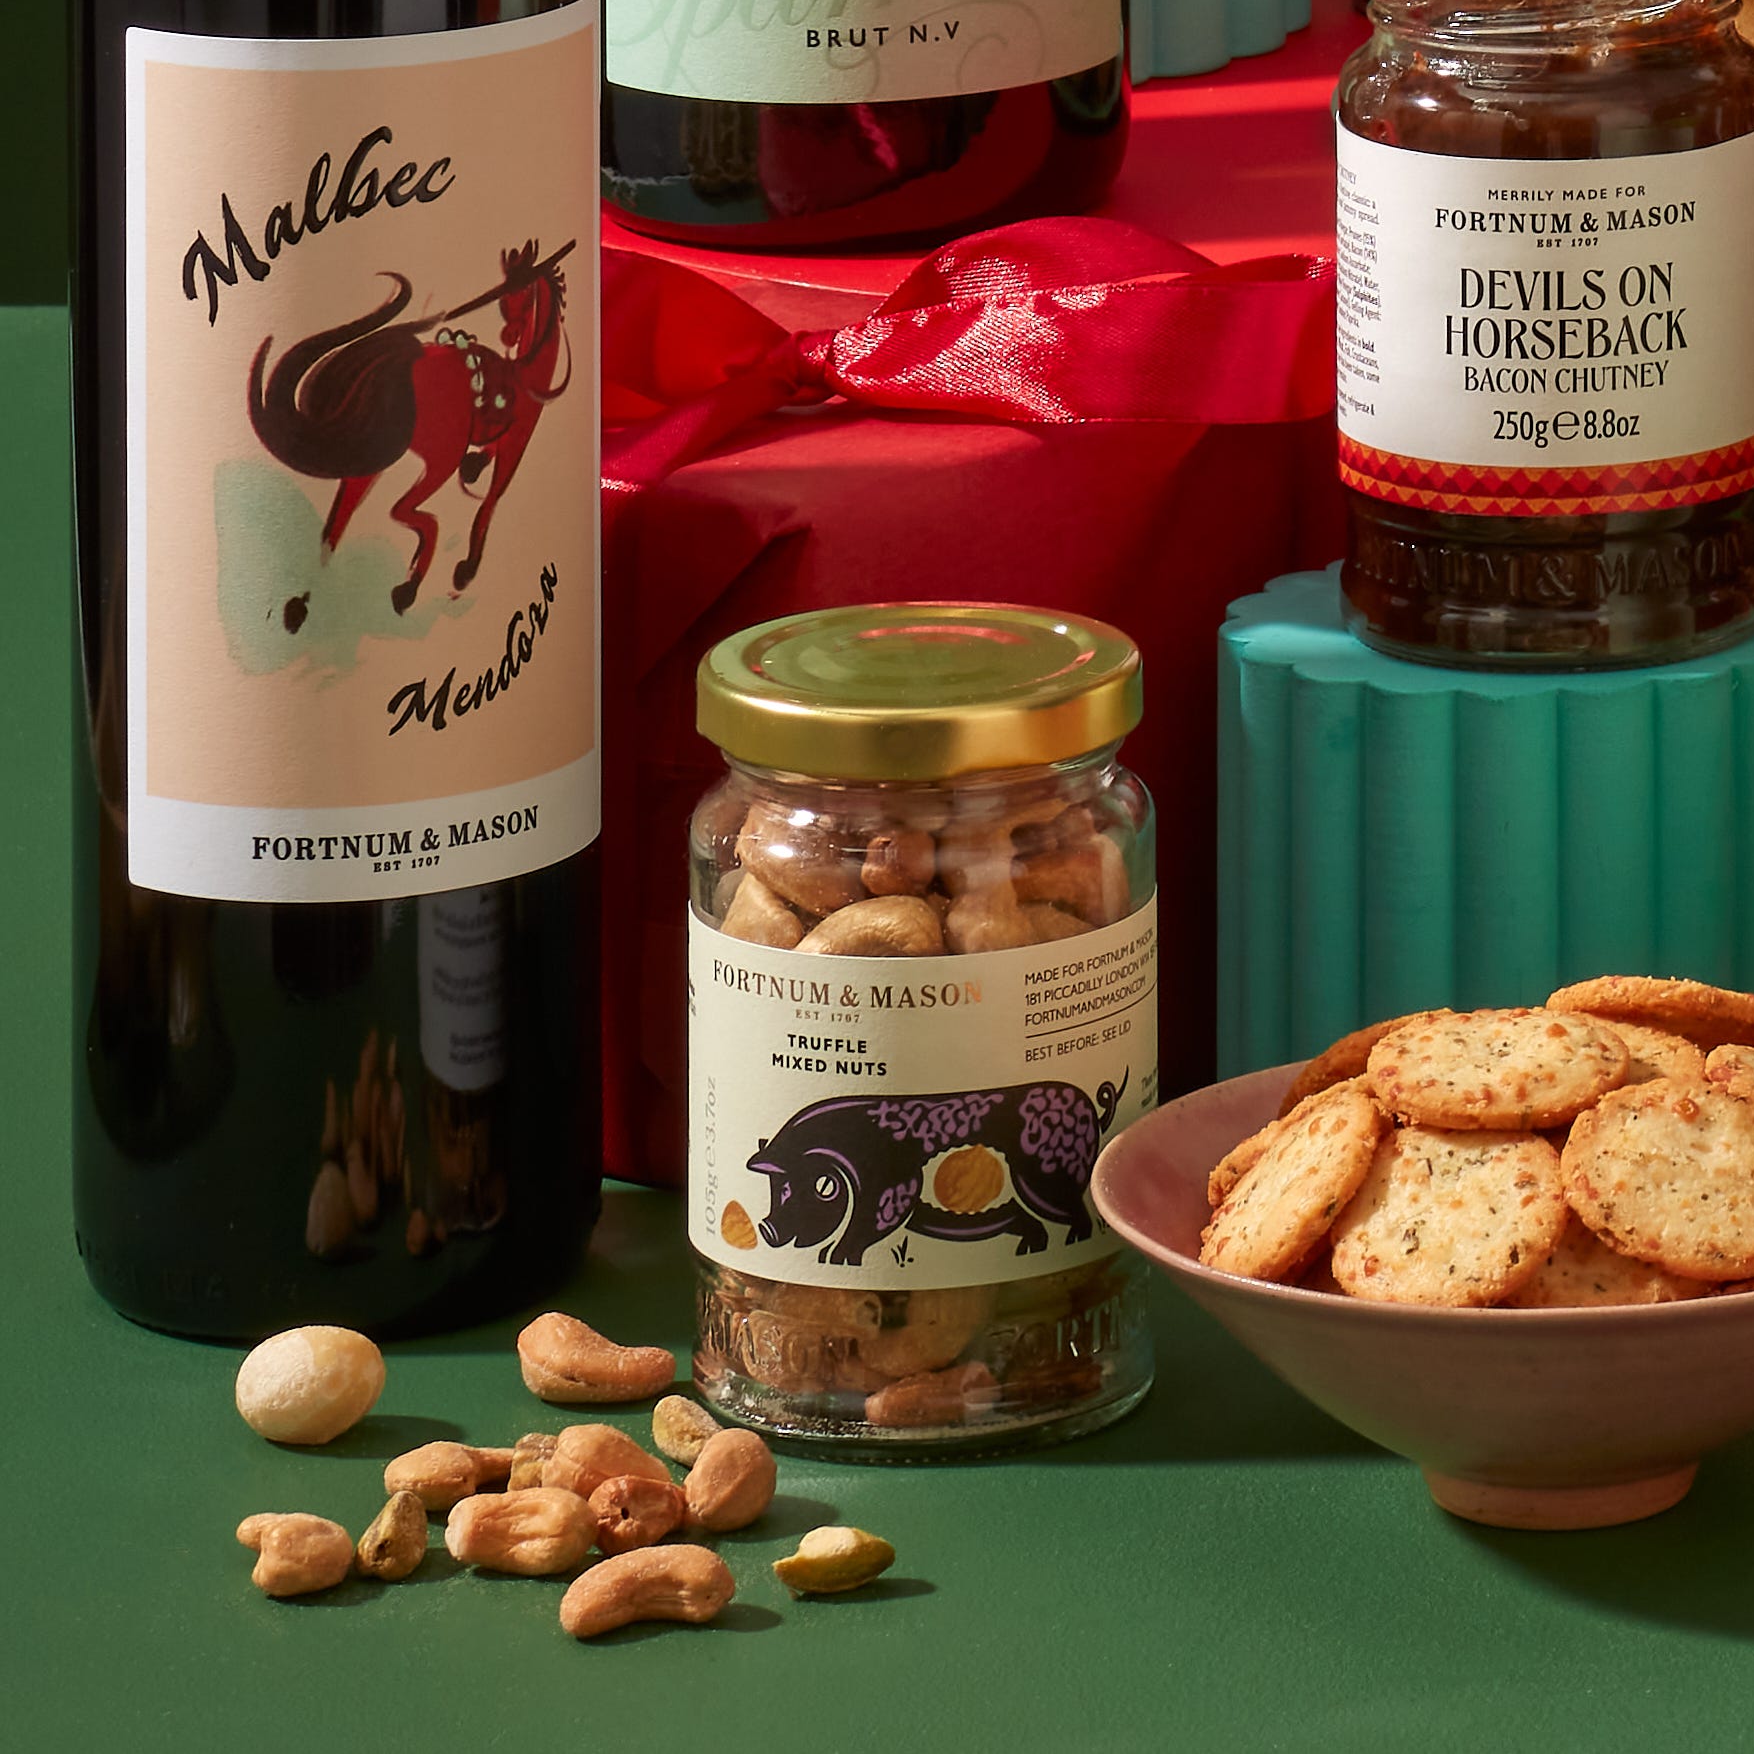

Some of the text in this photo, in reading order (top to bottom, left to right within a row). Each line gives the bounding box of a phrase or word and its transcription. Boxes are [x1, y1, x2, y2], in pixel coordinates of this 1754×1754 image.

[806, 20, 960, 52] BRUT N.V
[183, 125, 456, 327] Malbec
[1434, 200, 1696, 235] FORTNUM & MASON
[1460, 261, 1674, 312] DEVILS ON
[1445, 307, 1688, 361] HORSEBACK
[1464, 359, 1670, 395] BACON CHUTNEY
[386, 562, 557, 737] Mendoza
[251, 804, 539, 861] FORTNUM & MASON
[713, 959, 830, 1006] FORTNUM
[839, 984, 860, 1008] &
[869, 979, 983, 1010] MASON
[772, 1052, 888, 1077] MIXED NUTS
[786, 1033, 867, 1054] TRUFFLE
